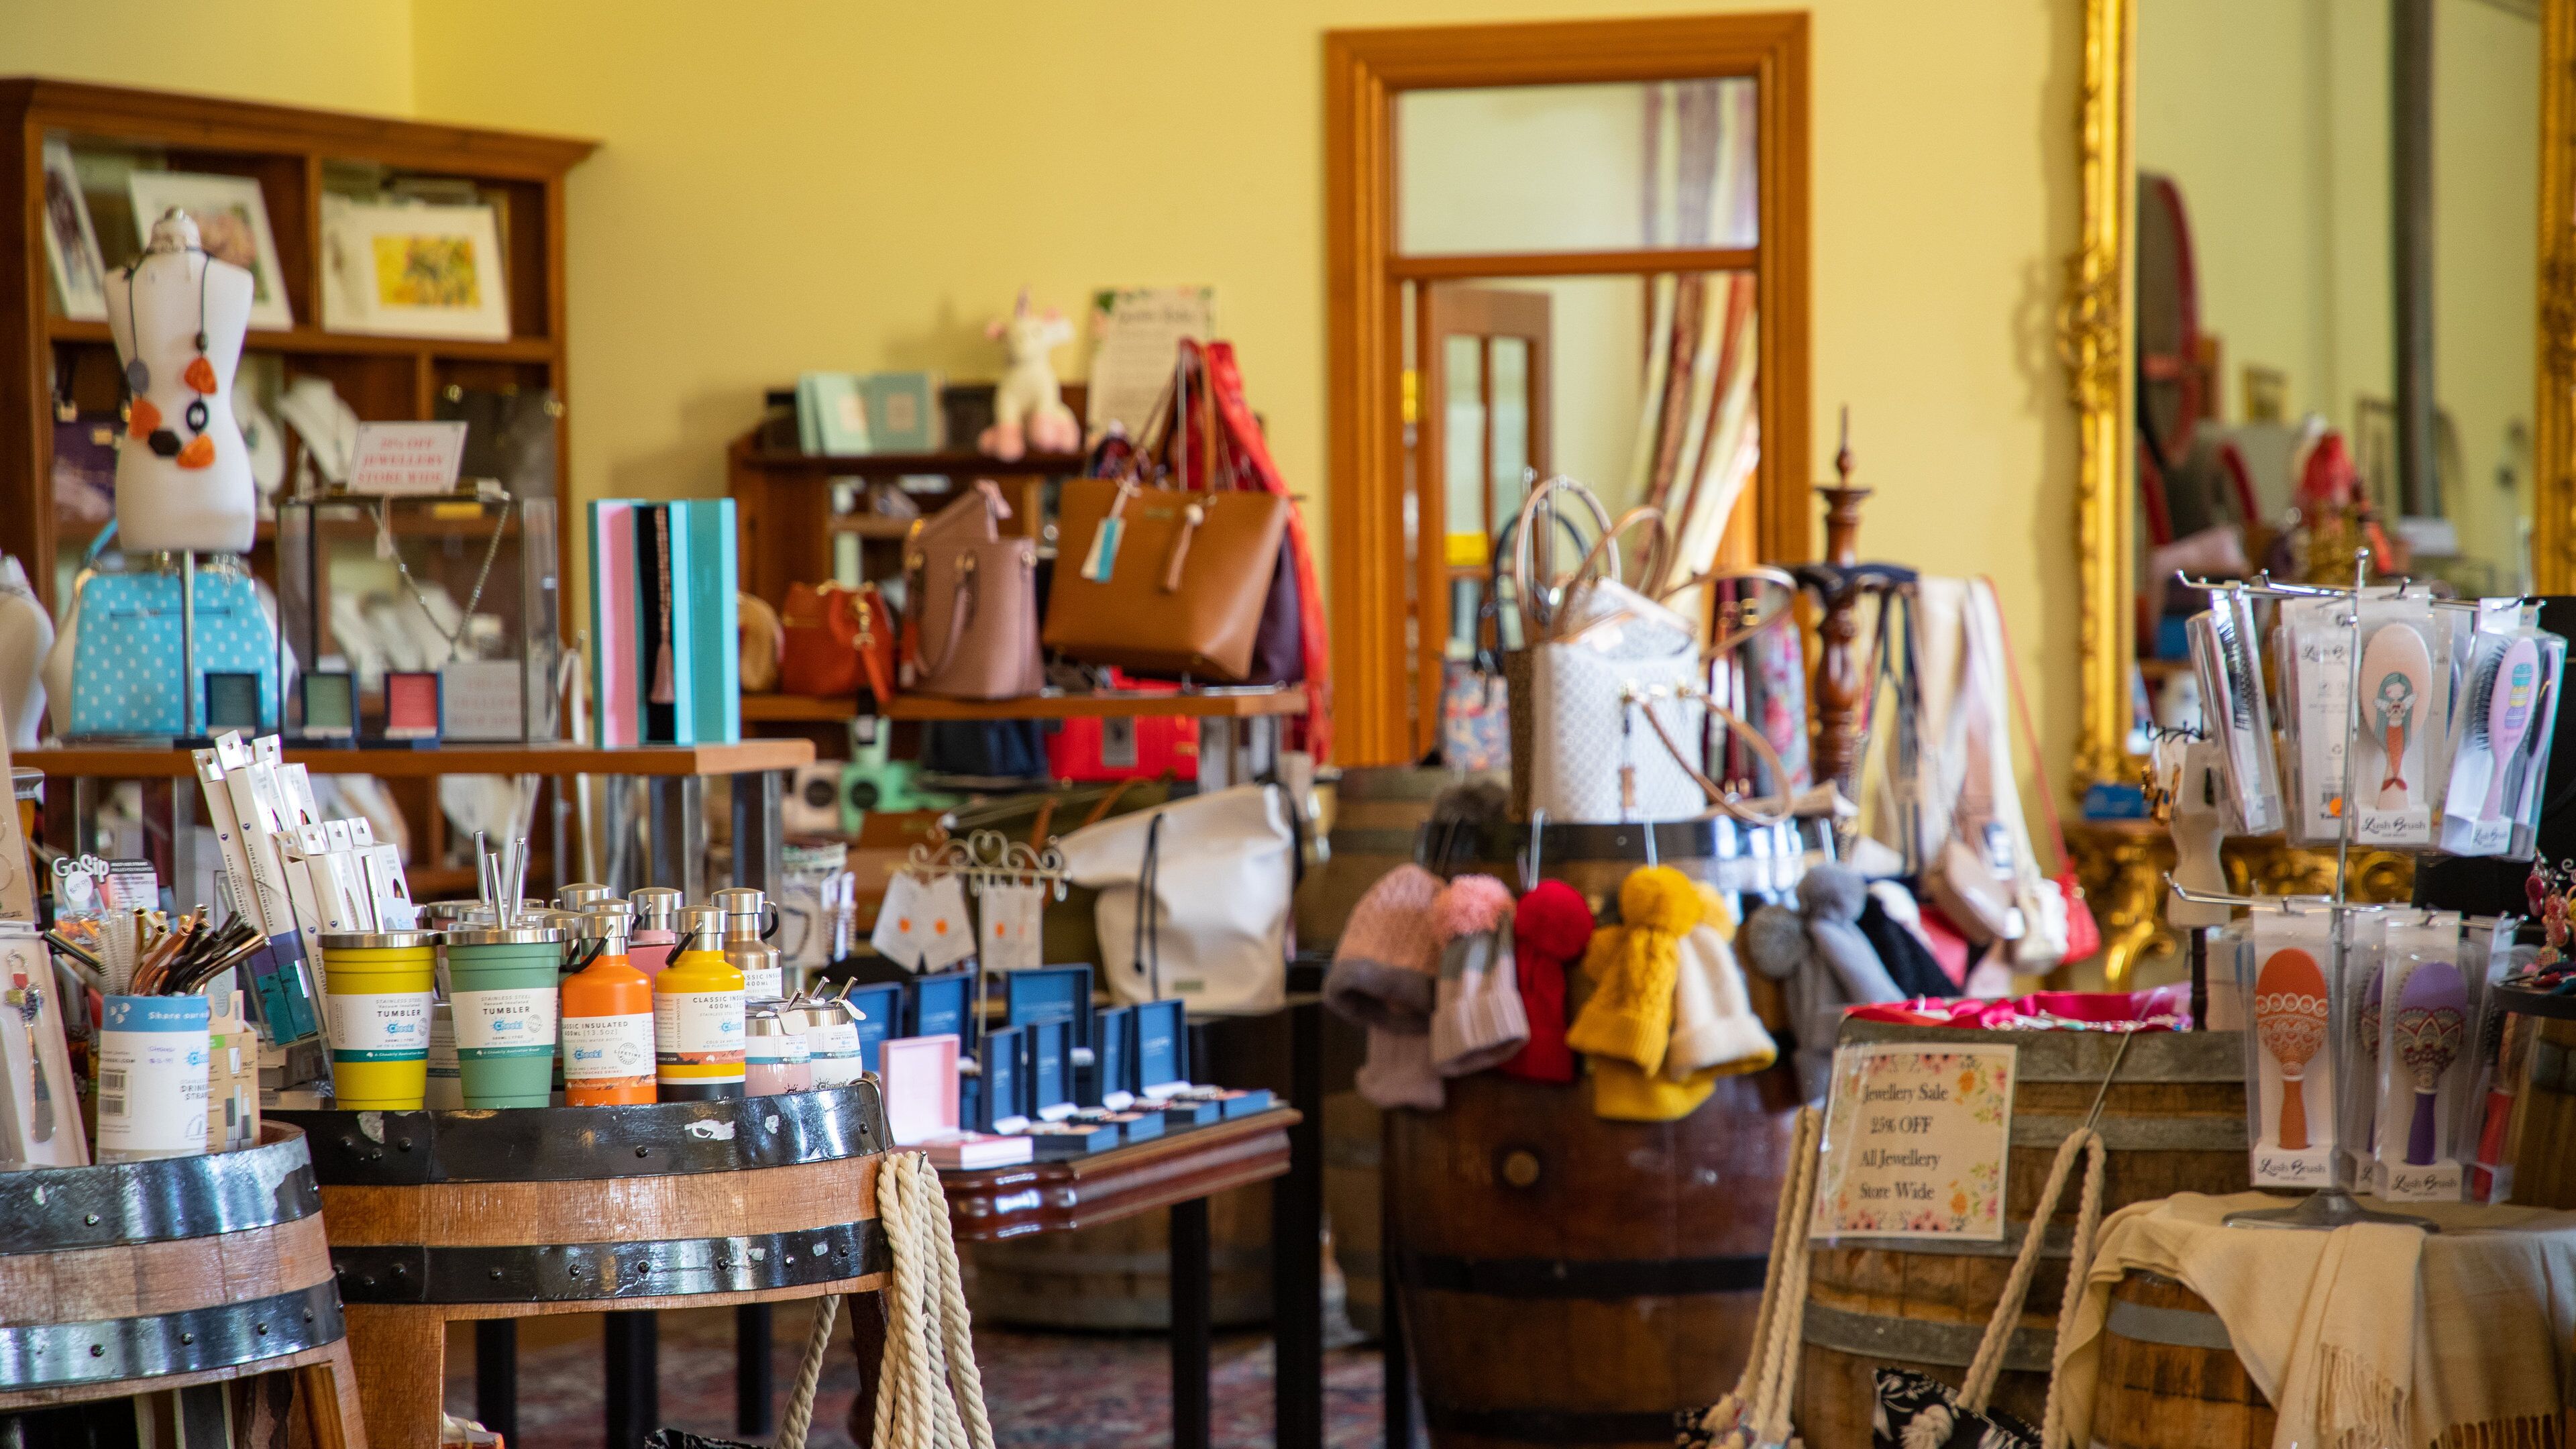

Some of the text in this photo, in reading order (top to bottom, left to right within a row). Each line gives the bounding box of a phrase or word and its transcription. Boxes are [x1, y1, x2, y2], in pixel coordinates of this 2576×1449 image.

[2361, 816, 2390, 834] Lush
[2393, 816, 2426, 832] Brush
[52, 854, 109, 883] GoSip
[149, 1012, 181, 1020] Share
[483, 1006, 530, 1014] TUMBLER
[582, 1021, 628, 1029] INSULATED
[1862, 1083, 1948, 1104] Jewellery Sale
[1871, 1116, 1933, 1134] 25% OFF
[1860, 1148, 1941, 1171] All Jewellery
[2257, 1158, 2326, 1177] Lush Brush
[1860, 1181, 1935, 1199] Store Wide
[2392, 1174, 2457, 1193] Lush Brush
